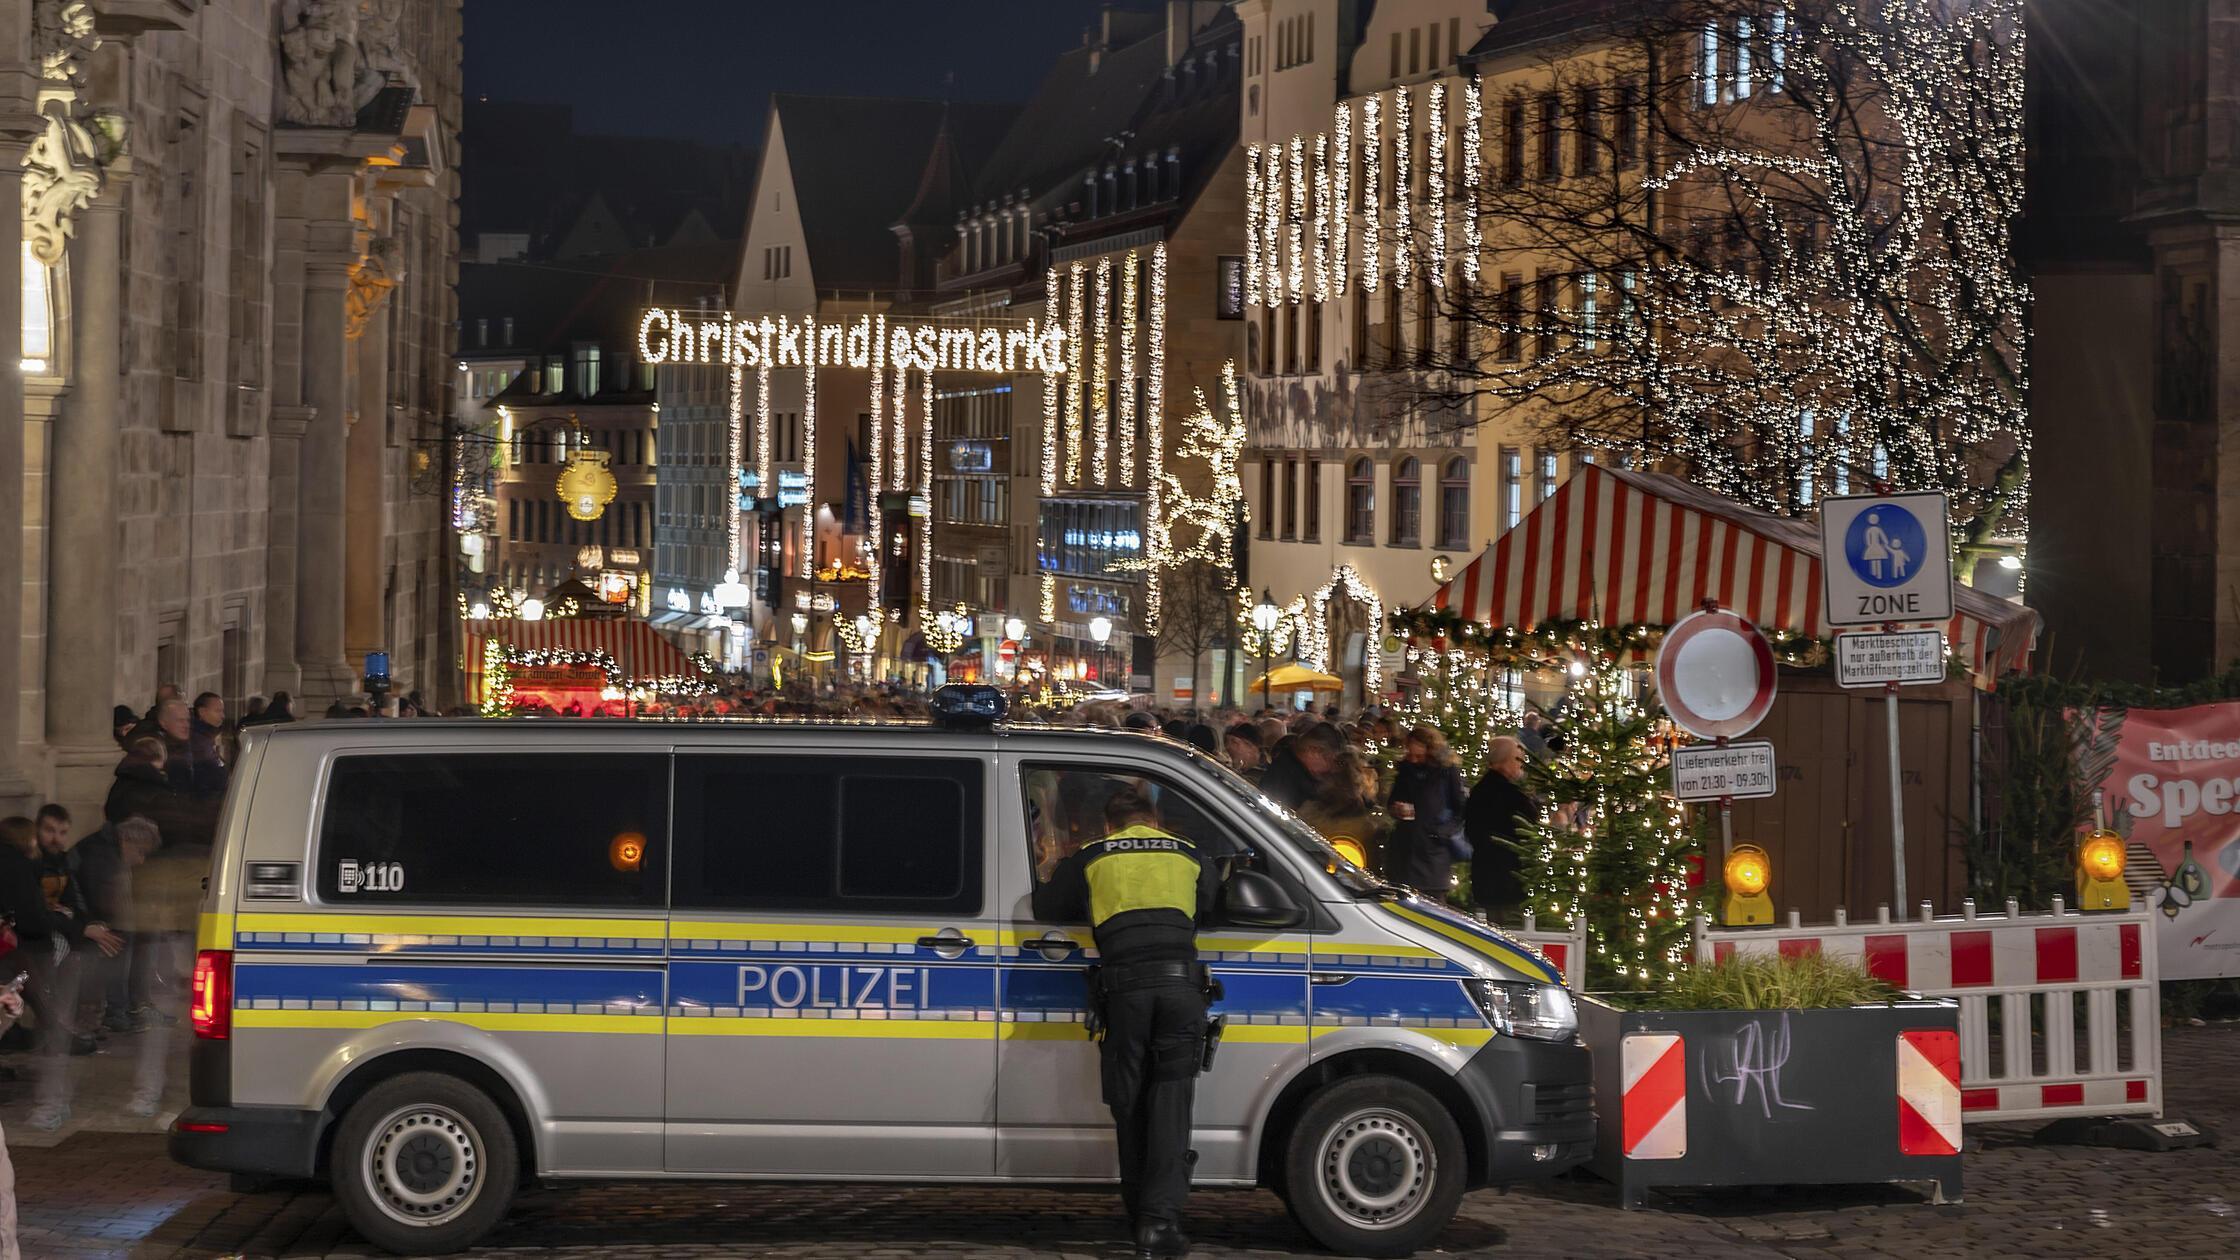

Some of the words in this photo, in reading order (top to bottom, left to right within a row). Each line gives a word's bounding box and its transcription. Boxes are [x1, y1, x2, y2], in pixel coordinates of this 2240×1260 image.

[639, 307, 1067, 373] Christkindlesmarkt
[1857, 593, 1921, 616] ZONE
[1852, 635, 1930, 650] Marktbeschicker
[1850, 652, 1866, 663] nur
[1869, 648, 1916, 663] außerhalb
[1918, 648, 1934, 660] der
[1844, 660, 1923, 678] Marktöffnungszeit
[1678, 751, 1749, 770] Lieferverkehr
[1751, 749, 1769, 765] frei
[2147, 740, 2240, 761] Entdec
[1680, 779, 1699, 792] von
[1104, 839, 1179, 852] POLIZEI
[364, 862, 404, 892] 110
[737, 965, 930, 1009] POLIZEI
